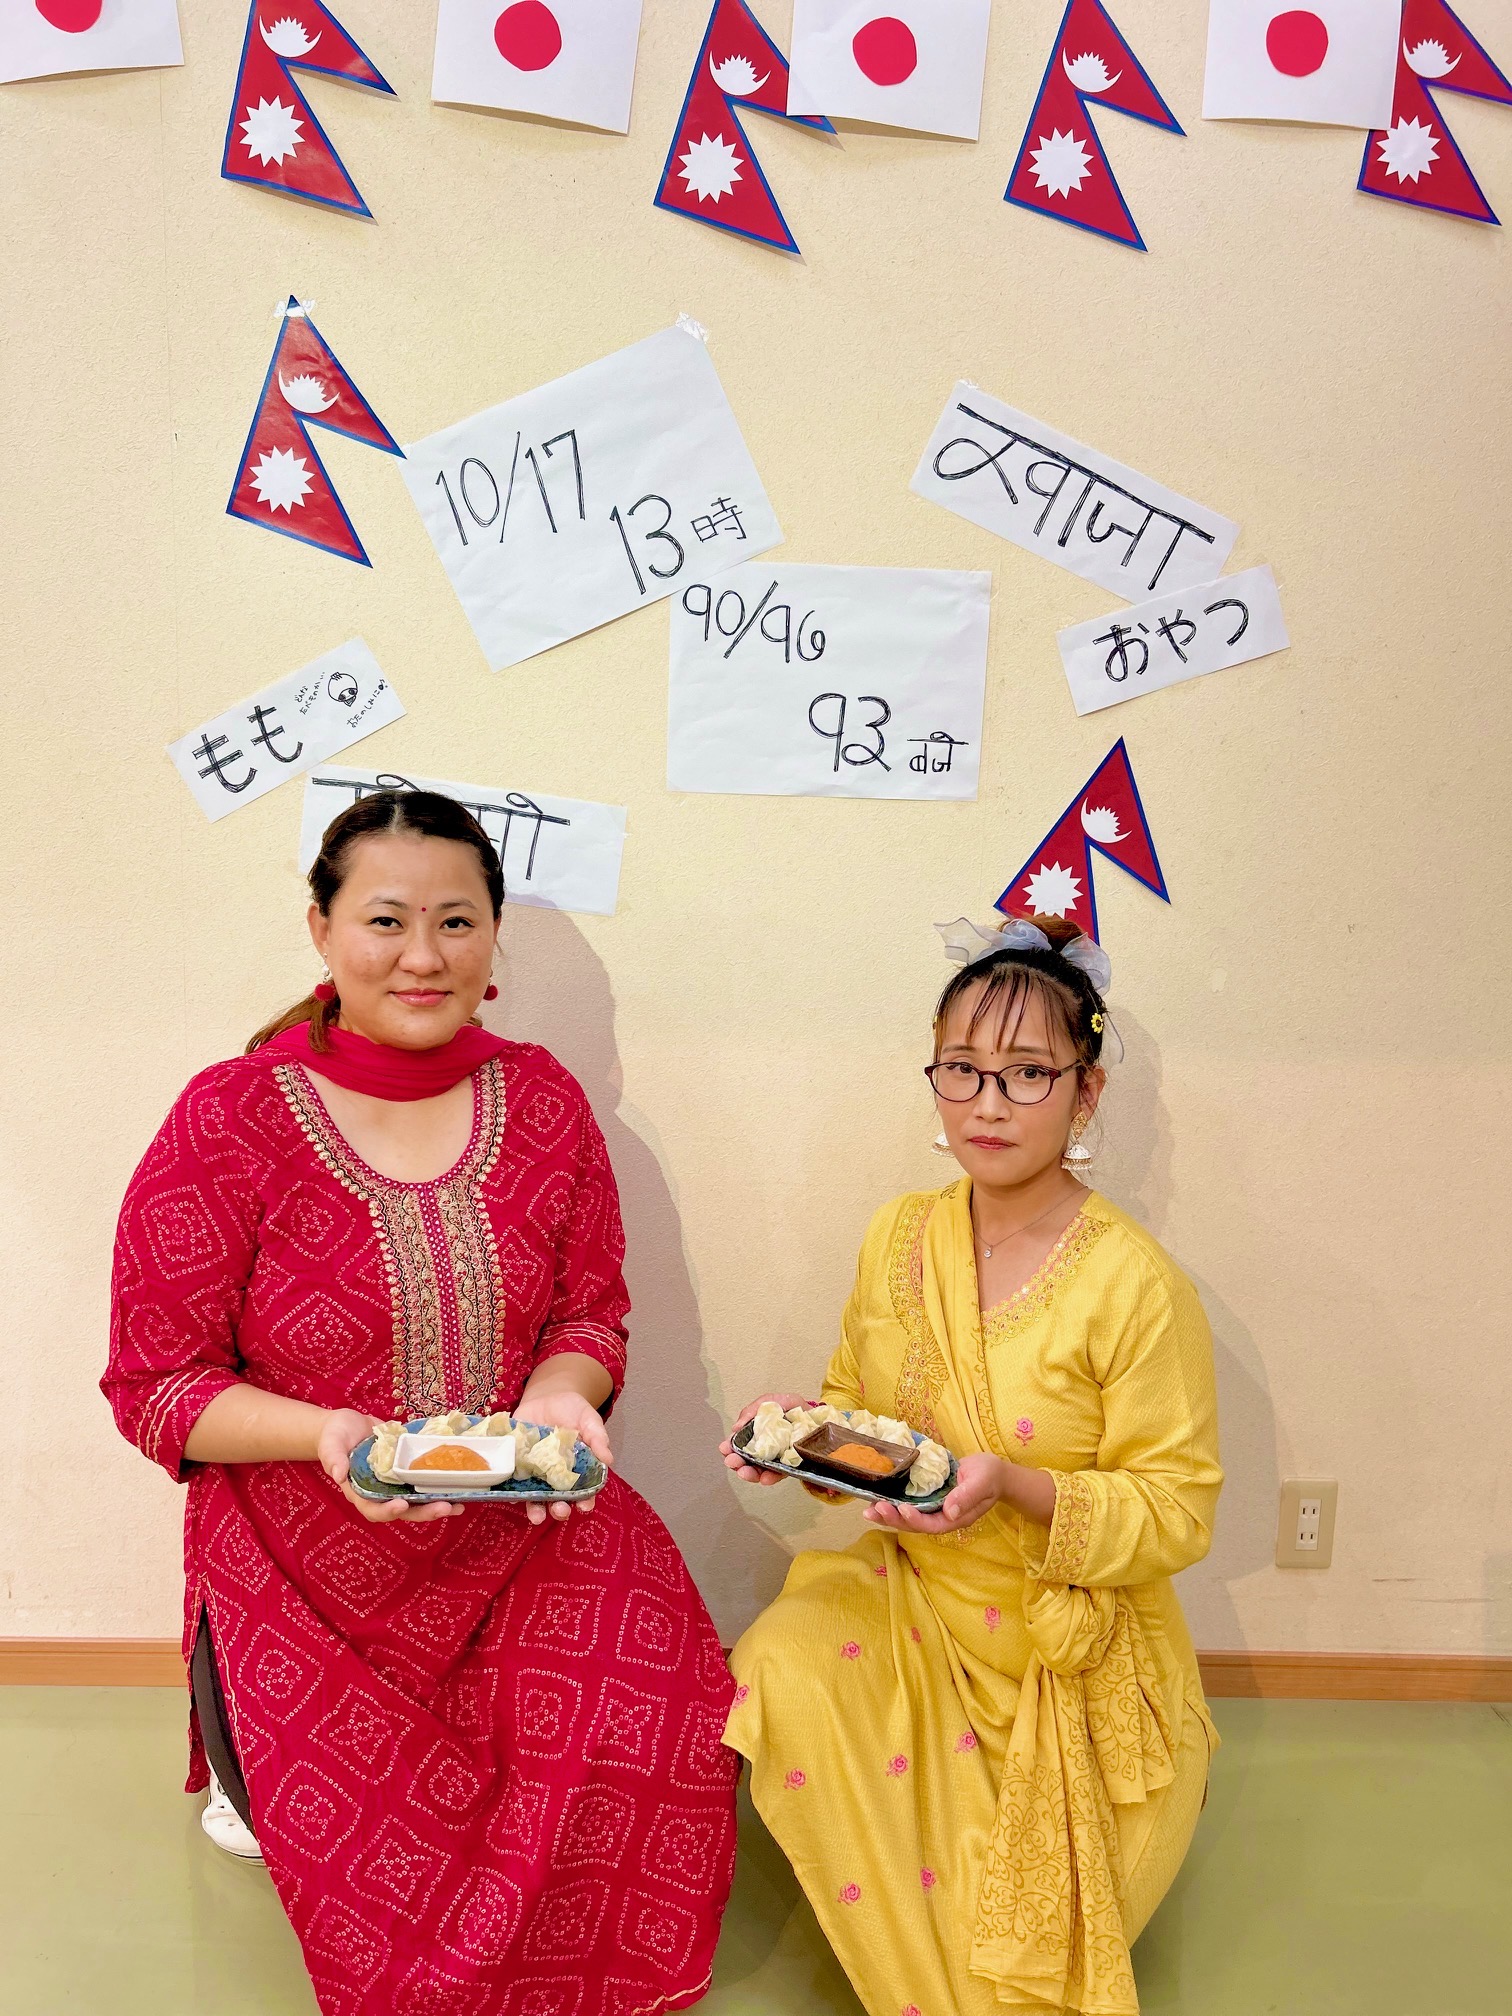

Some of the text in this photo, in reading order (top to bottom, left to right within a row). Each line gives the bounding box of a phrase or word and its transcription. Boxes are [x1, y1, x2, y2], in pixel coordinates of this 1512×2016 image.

[435, 429, 586, 546] 10/17
[609, 493, 747, 595] 13時
[682, 579, 826, 663] १०/१७
[1092, 598, 1249, 682] おやつ
[192, 705, 303, 793] もも
